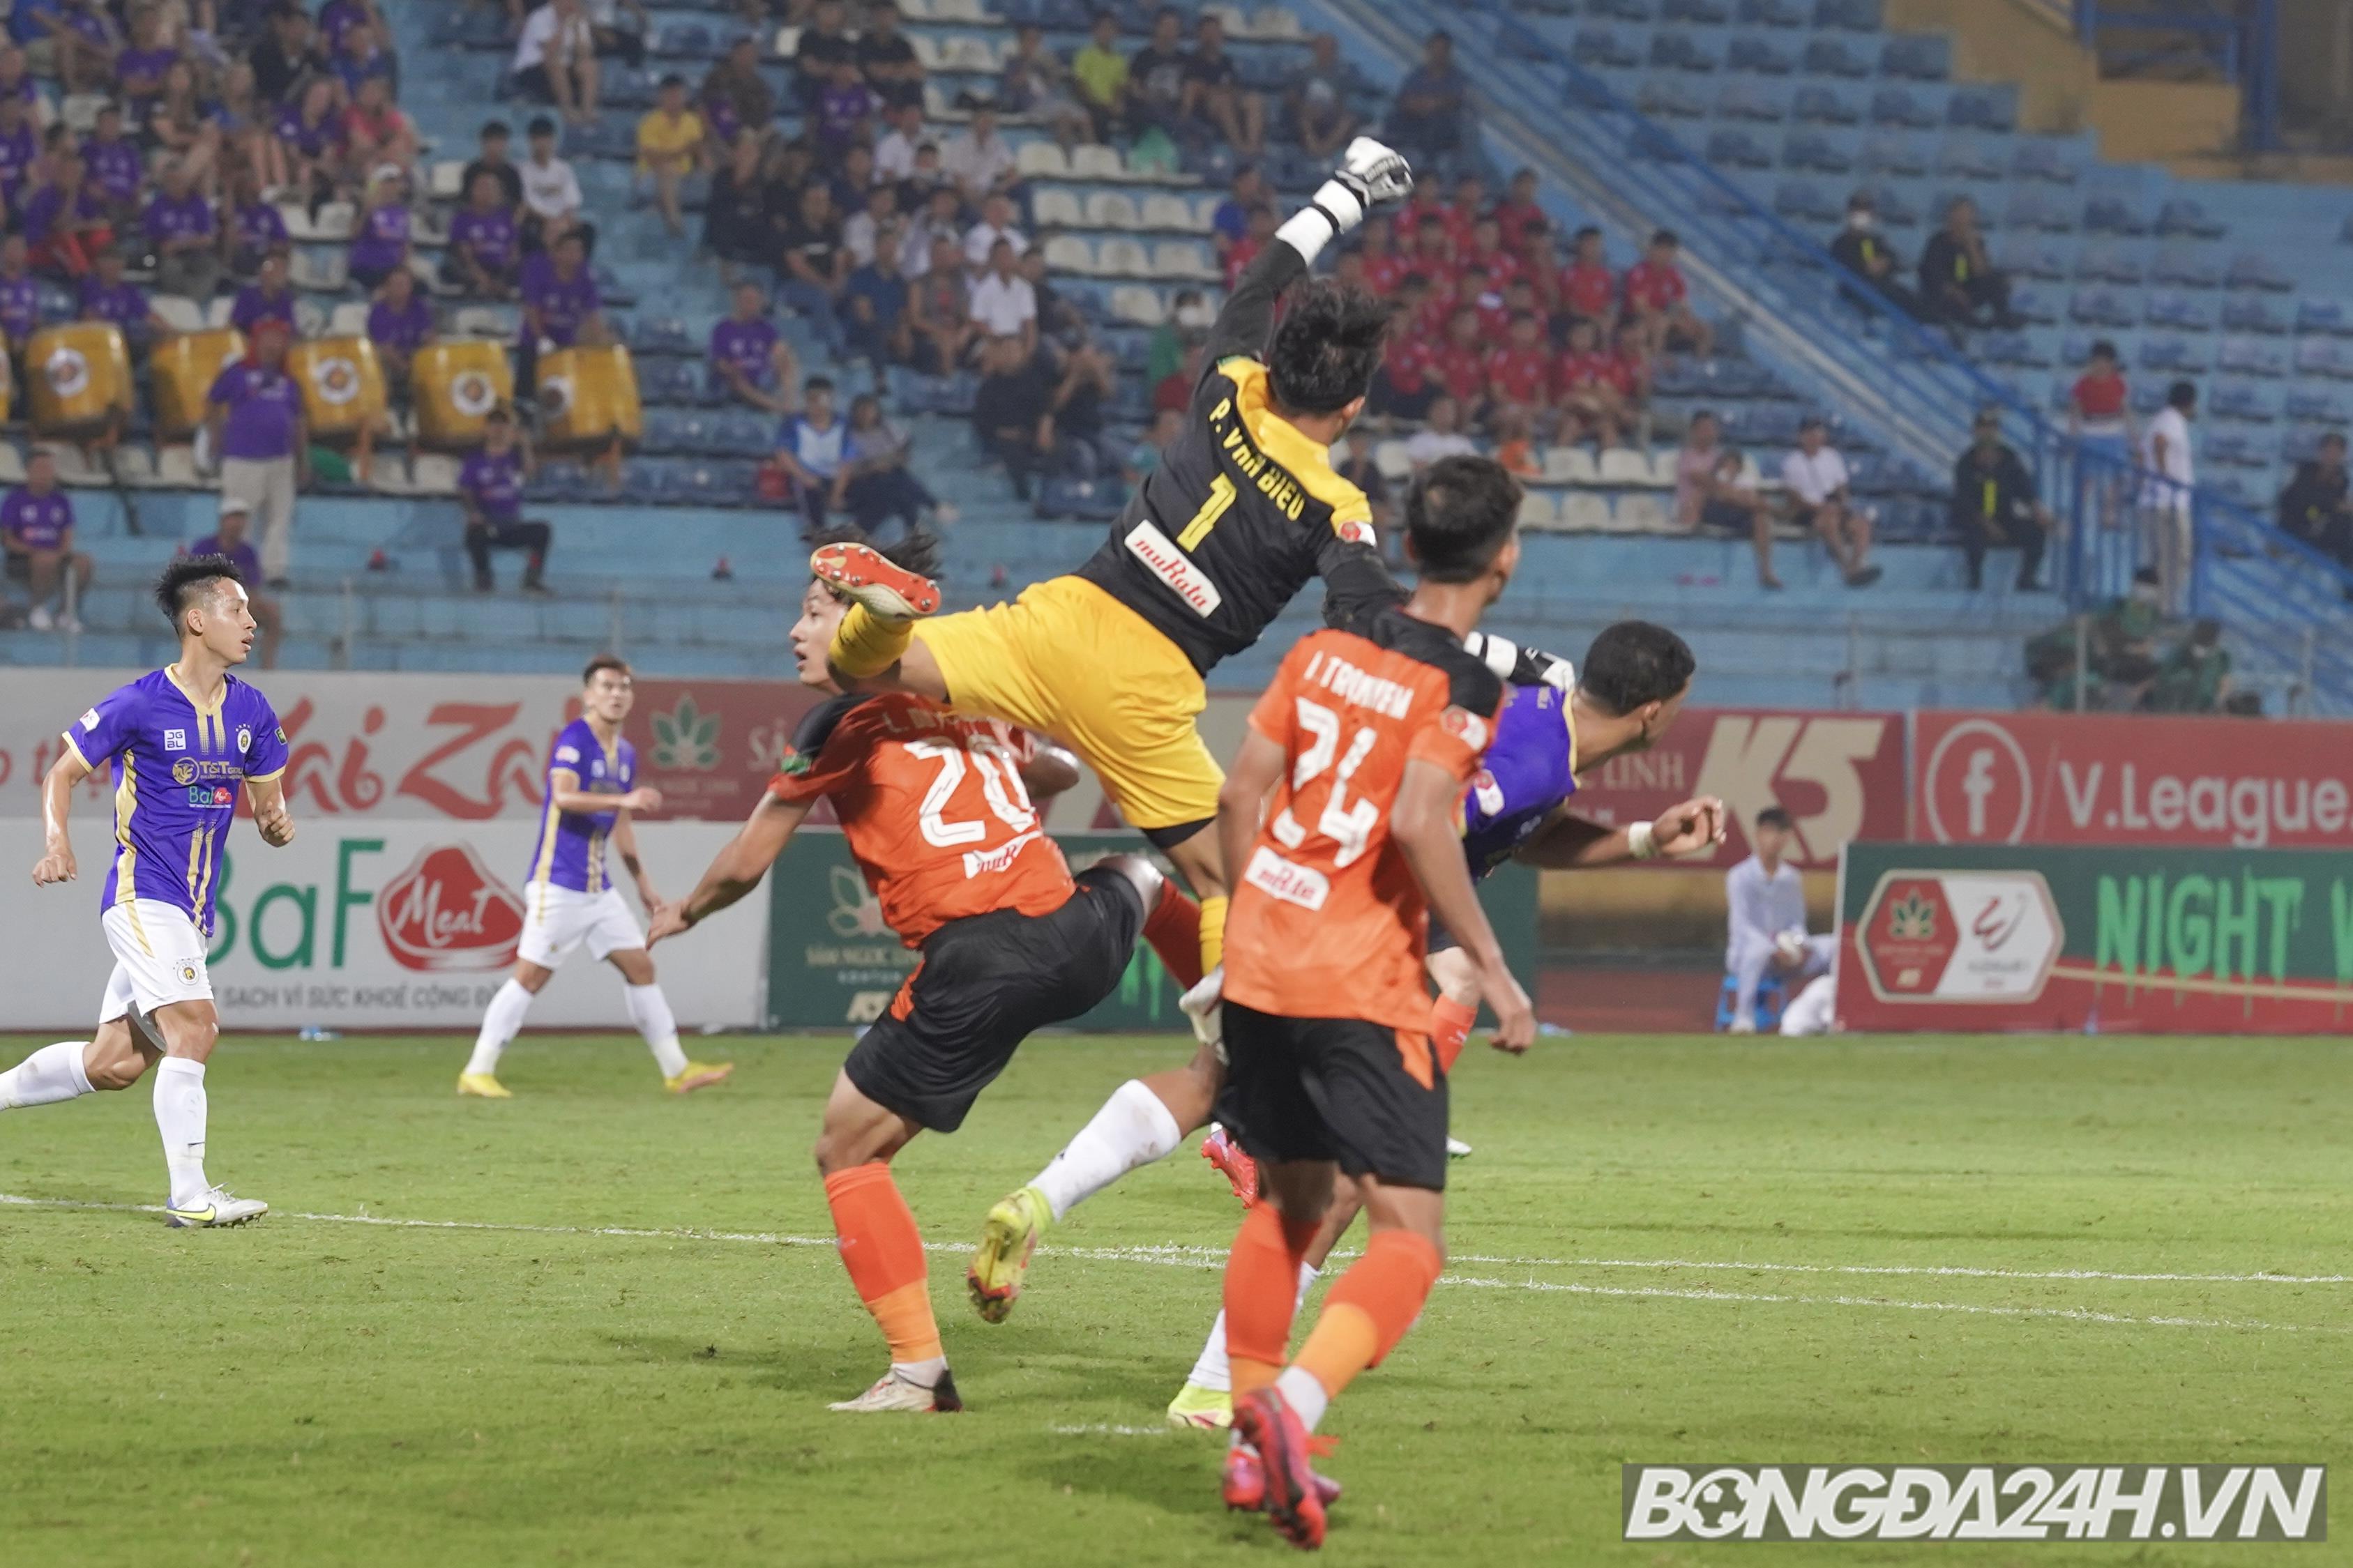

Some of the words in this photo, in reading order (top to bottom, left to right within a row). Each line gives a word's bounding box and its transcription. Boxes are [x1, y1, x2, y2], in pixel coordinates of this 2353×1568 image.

[1176, 471, 1237, 553] 1
[1134, 539, 1207, 609] muRata
[903, 736, 1037, 846] 20
[1271, 696, 1380, 869] 24
[1675, 715, 1886, 863] K5
[393, 874, 496, 949] Meat
[2095, 865, 2304, 994] NIGHT
